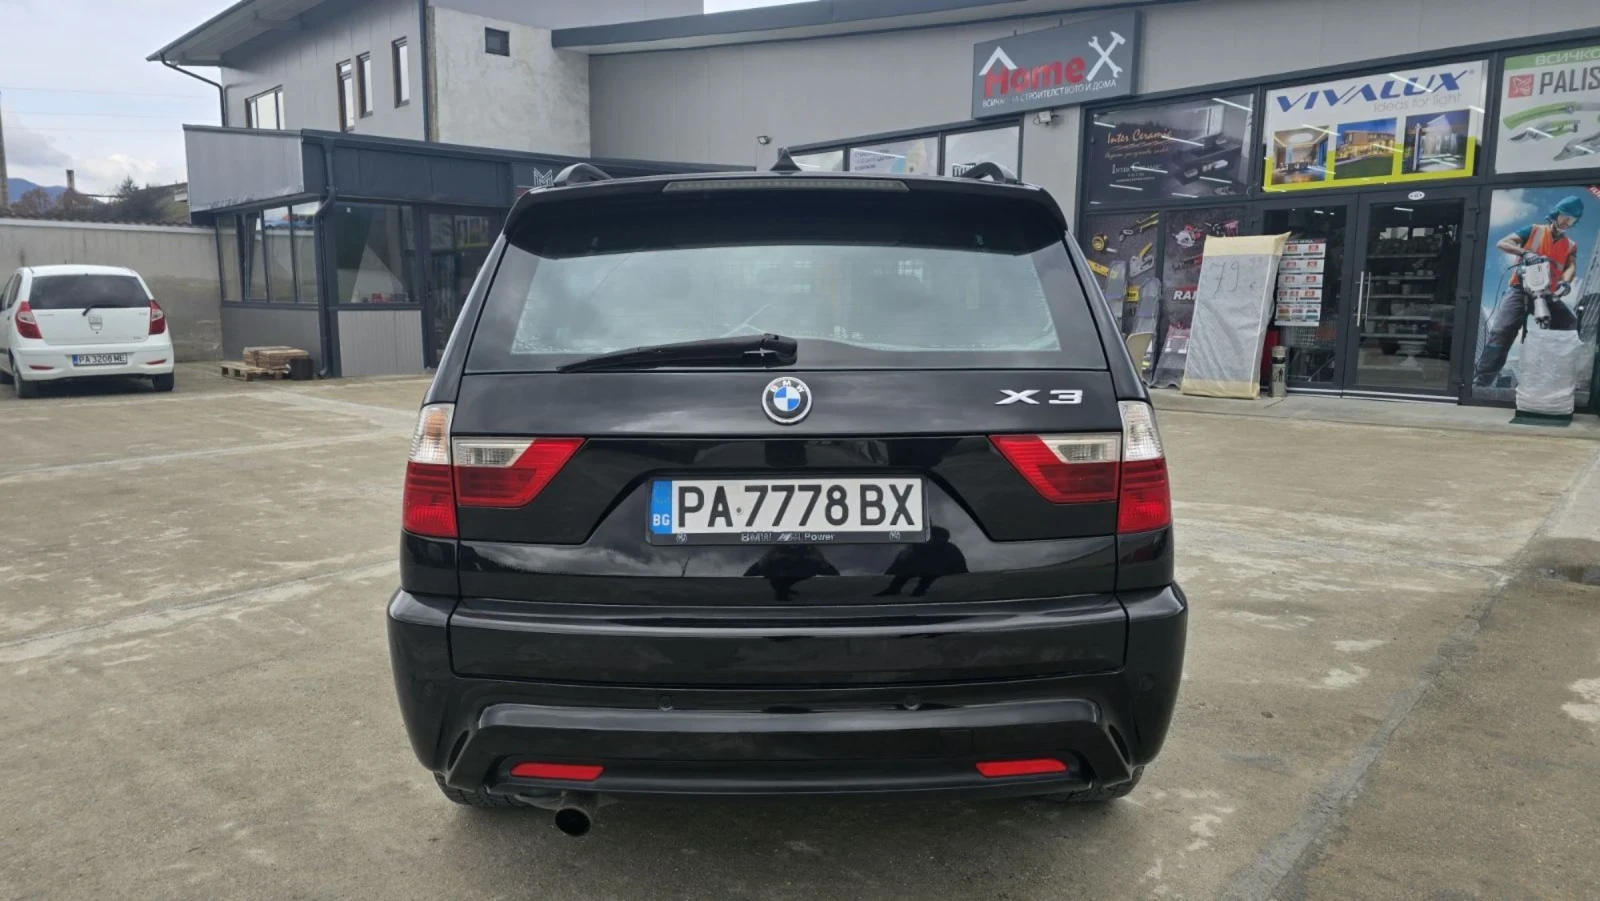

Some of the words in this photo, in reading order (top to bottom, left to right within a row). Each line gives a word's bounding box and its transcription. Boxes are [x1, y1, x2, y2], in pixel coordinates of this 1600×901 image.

[982, 97, 1010, 108] ВСИЧК
[1092, 79, 1117, 93] ДОМА
[1276, 70, 1469, 113] VIVALUX
[1412, 95, 1430, 109] for
[1432, 92, 1463, 109] light
[1107, 131, 1129, 144] Inter
[79, 355, 91, 364] PA
[770, 380, 804, 393] BMW
[678, 486, 734, 528] PA
[744, 484, 849, 527] 7778
[859, 484, 915, 526] BX
[653, 514, 670, 527] BG
[741, 532, 772, 542] BMW
[804, 532, 835, 541] Power
